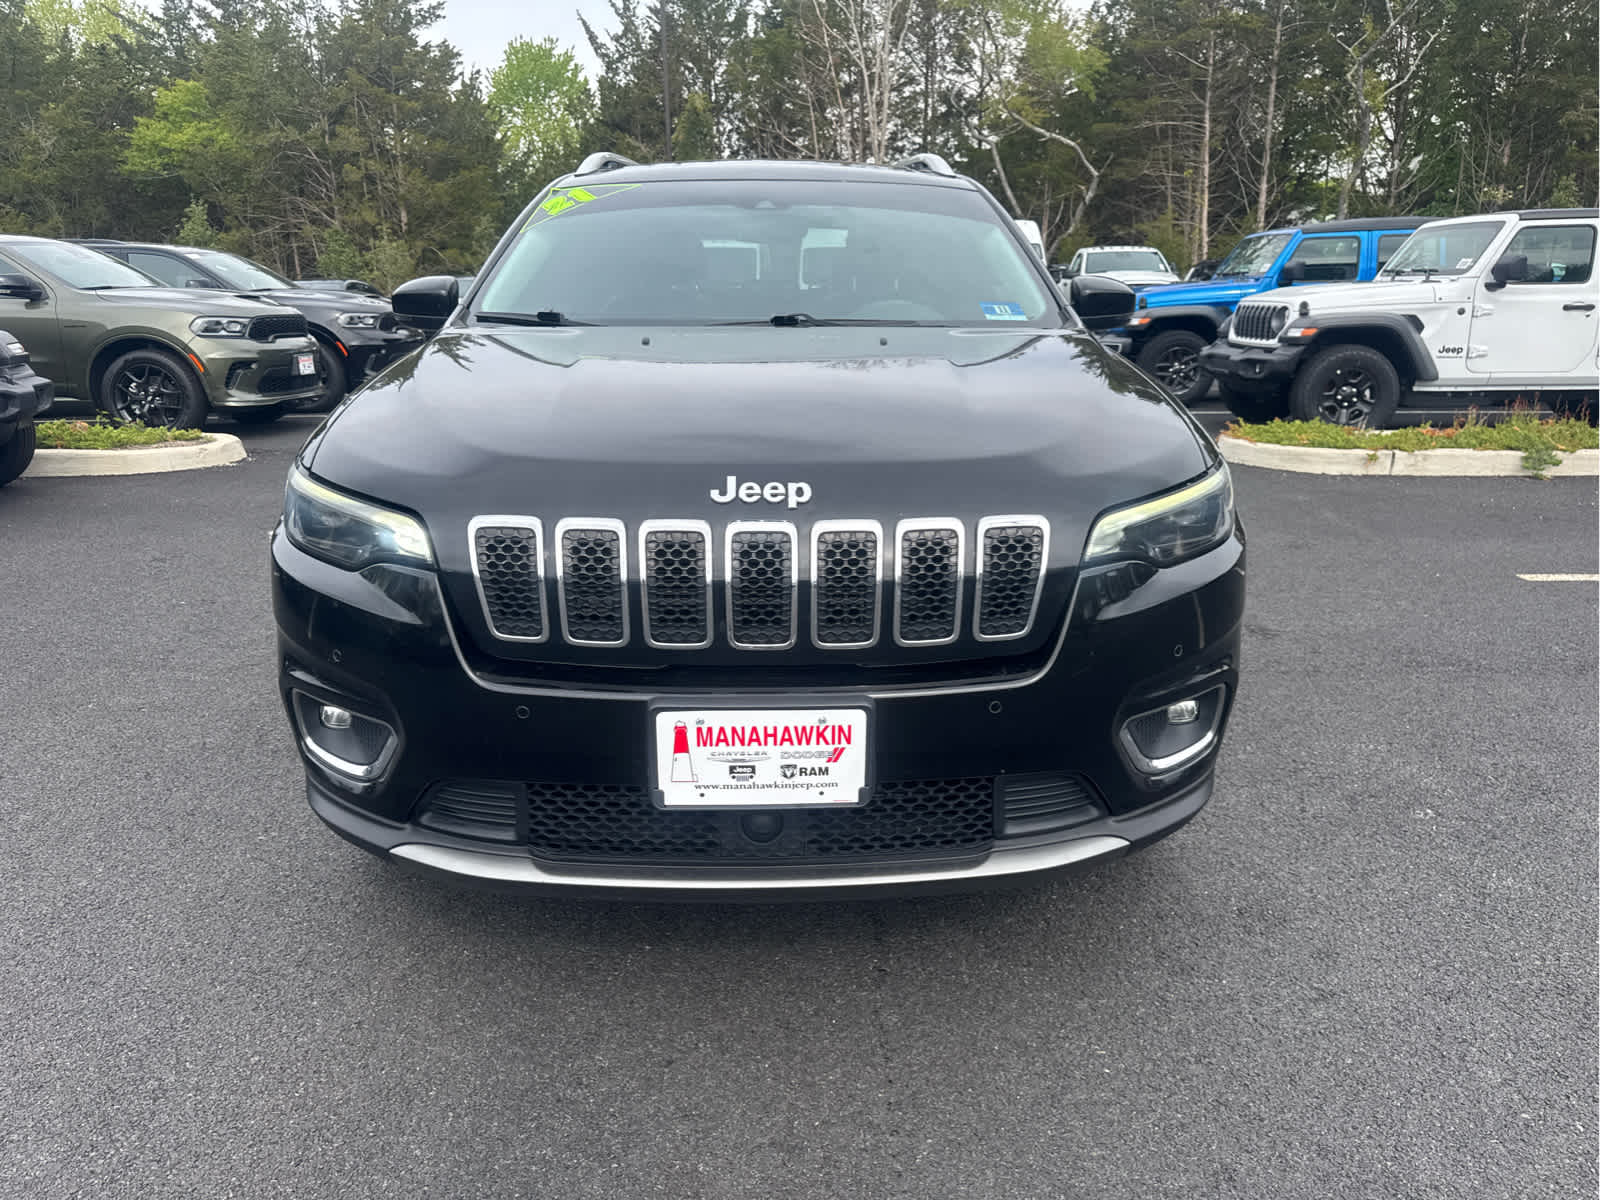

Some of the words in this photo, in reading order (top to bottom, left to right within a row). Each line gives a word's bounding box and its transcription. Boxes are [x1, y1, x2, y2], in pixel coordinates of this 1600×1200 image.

[1438, 344, 1464, 356] Jeep
[710, 475, 812, 509] Jeep
[695, 724, 853, 747] MANAHAWKIN
[780, 750, 834, 760] DODGE
[799, 766, 829, 776] RAM
[694, 781, 839, 791] www.manahawkinjeep.com
